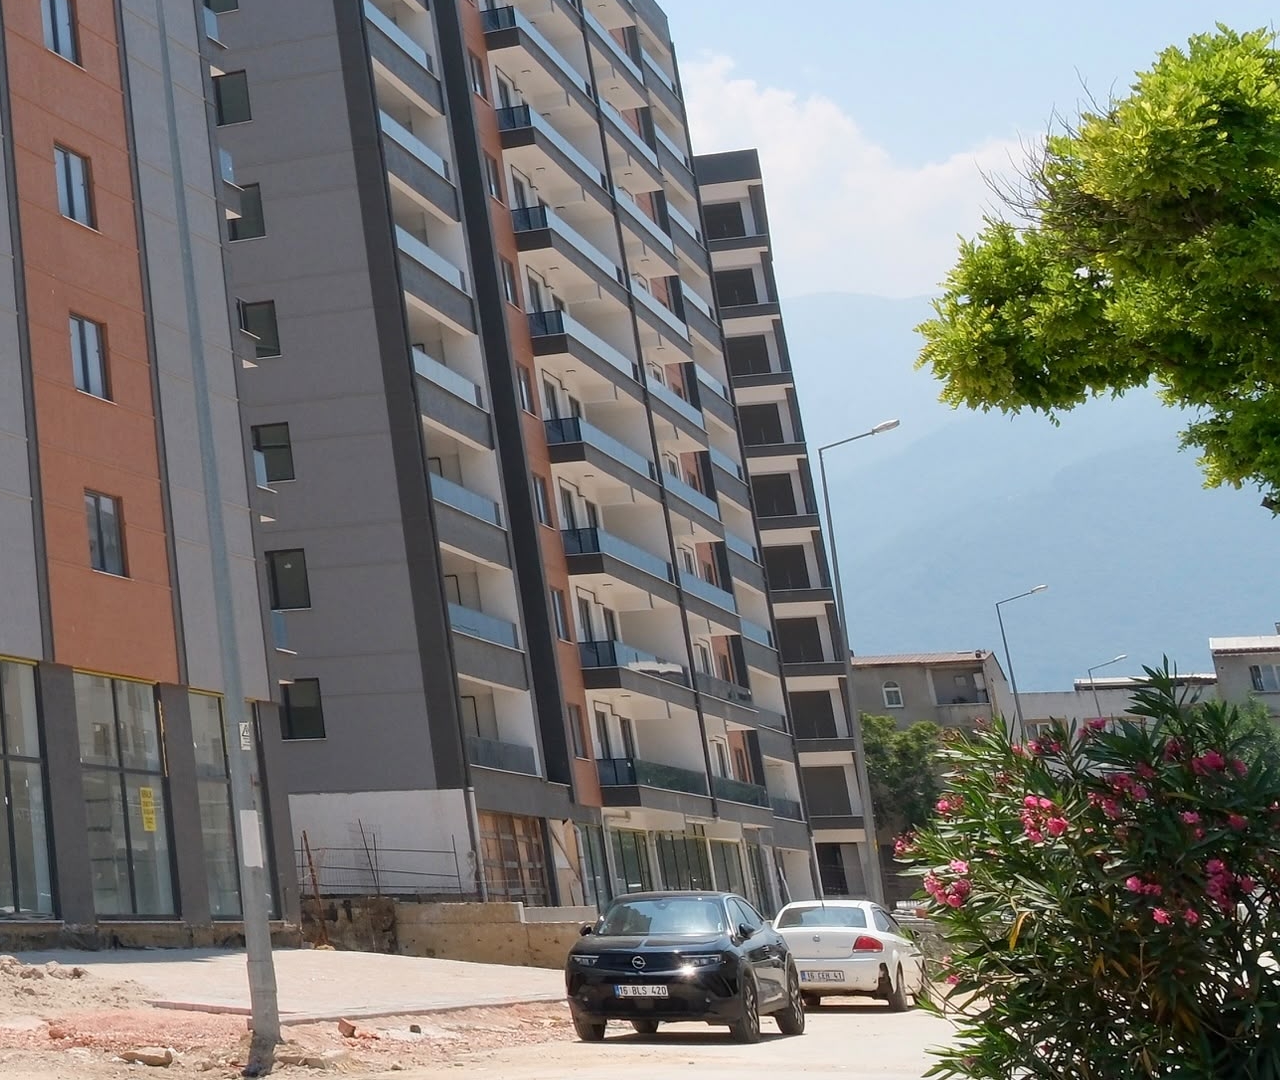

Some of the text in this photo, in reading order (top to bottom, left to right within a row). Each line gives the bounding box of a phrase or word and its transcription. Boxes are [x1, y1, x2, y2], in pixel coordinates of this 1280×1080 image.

[620, 986, 666, 995] 16 BLS 420
